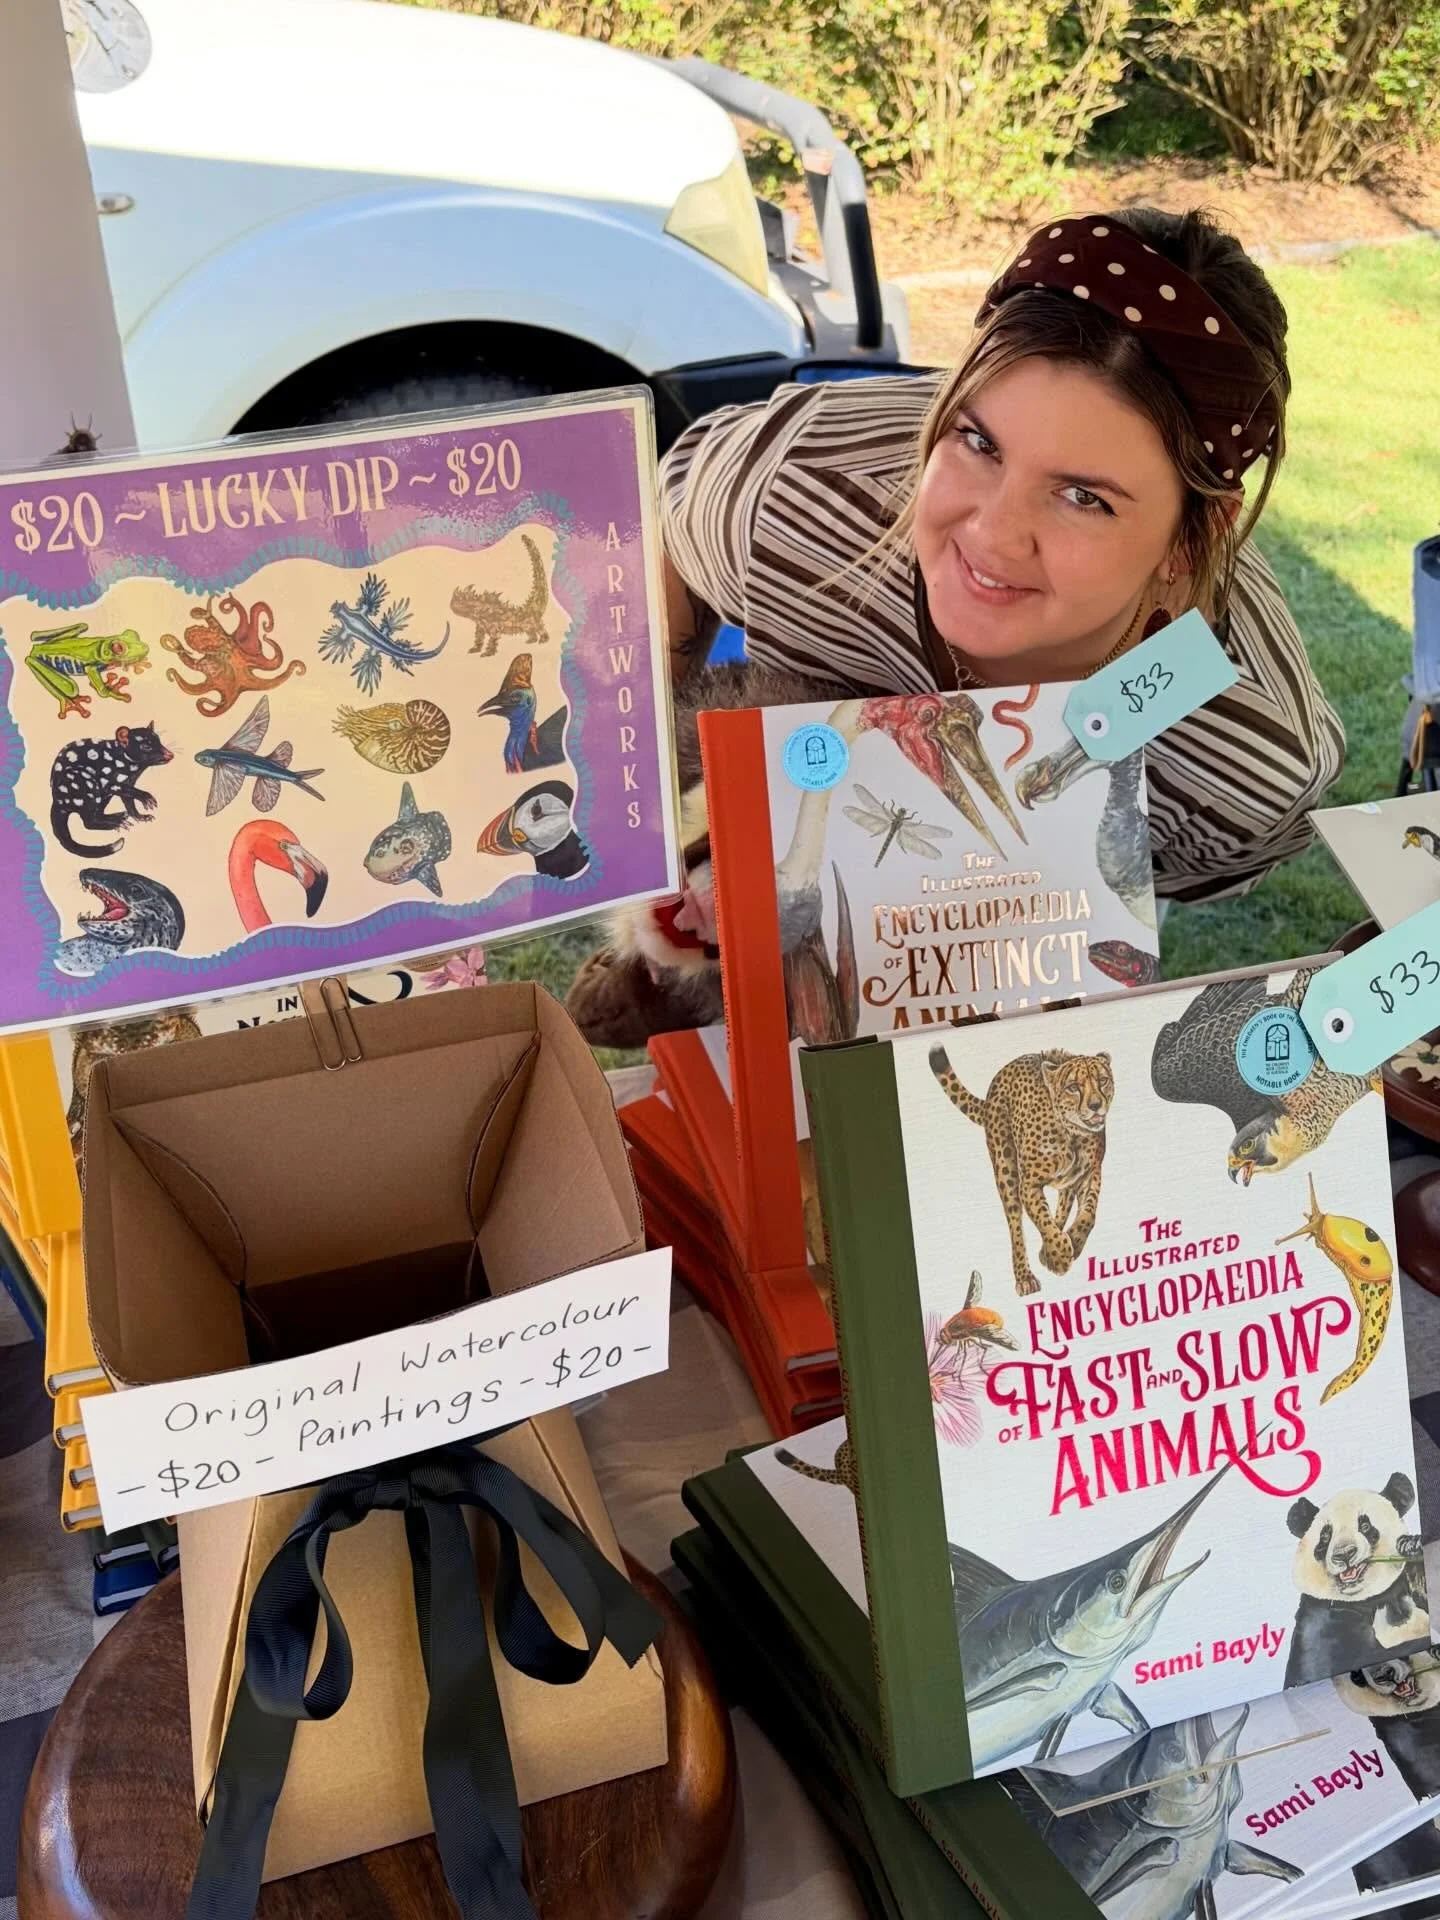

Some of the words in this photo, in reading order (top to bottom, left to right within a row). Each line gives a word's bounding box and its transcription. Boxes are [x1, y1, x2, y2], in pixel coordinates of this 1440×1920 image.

[11, 492, 103, 554] $20
[159, 463, 310, 538] LUCKY
[327, 455, 399, 518] DIP
[447, 439, 522, 498] $20
[1119, 661, 1175, 714] $33
[920, 871, 1042, 894] ILLUSTRATED
[963, 851, 995, 871] THE
[872, 888, 1094, 949] ENCYCLOPAEDIA
[862, 930, 1088, 1007] EXTINCT
[884, 957, 903, 970] OF
[1369, 950, 1440, 1014] $33
[277, 996, 298, 1013] IN
[1256, 1075, 1282, 1089] NOTABLE
[1284, 1070, 1302, 1086] BOOK
[1087, 1233, 1240, 1282] ILLUSTRATED
[1139, 1217, 1183, 1244] THE
[1026, 1251, 1304, 1360] ENCYCLOPAEDIA
[165, 1361, 362, 1439] Original
[401, 1294, 640, 1375] Watercolour
[1145, 1368, 1184, 1389] AND
[1176, 1295, 1352, 1402] SLOW
[298, 1379, 502, 1453] Paintings
[985, 1344, 1152, 1441] FAST
[998, 1424, 1023, 1444] OF
[1048, 1384, 1322, 1517] ANIMALS
[1134, 1642, 1204, 1684] Sami
[1211, 1623, 1286, 1665] Bayly
[1245, 1783, 1316, 1837] Sami
[1314, 1746, 1384, 1799] Bayly
